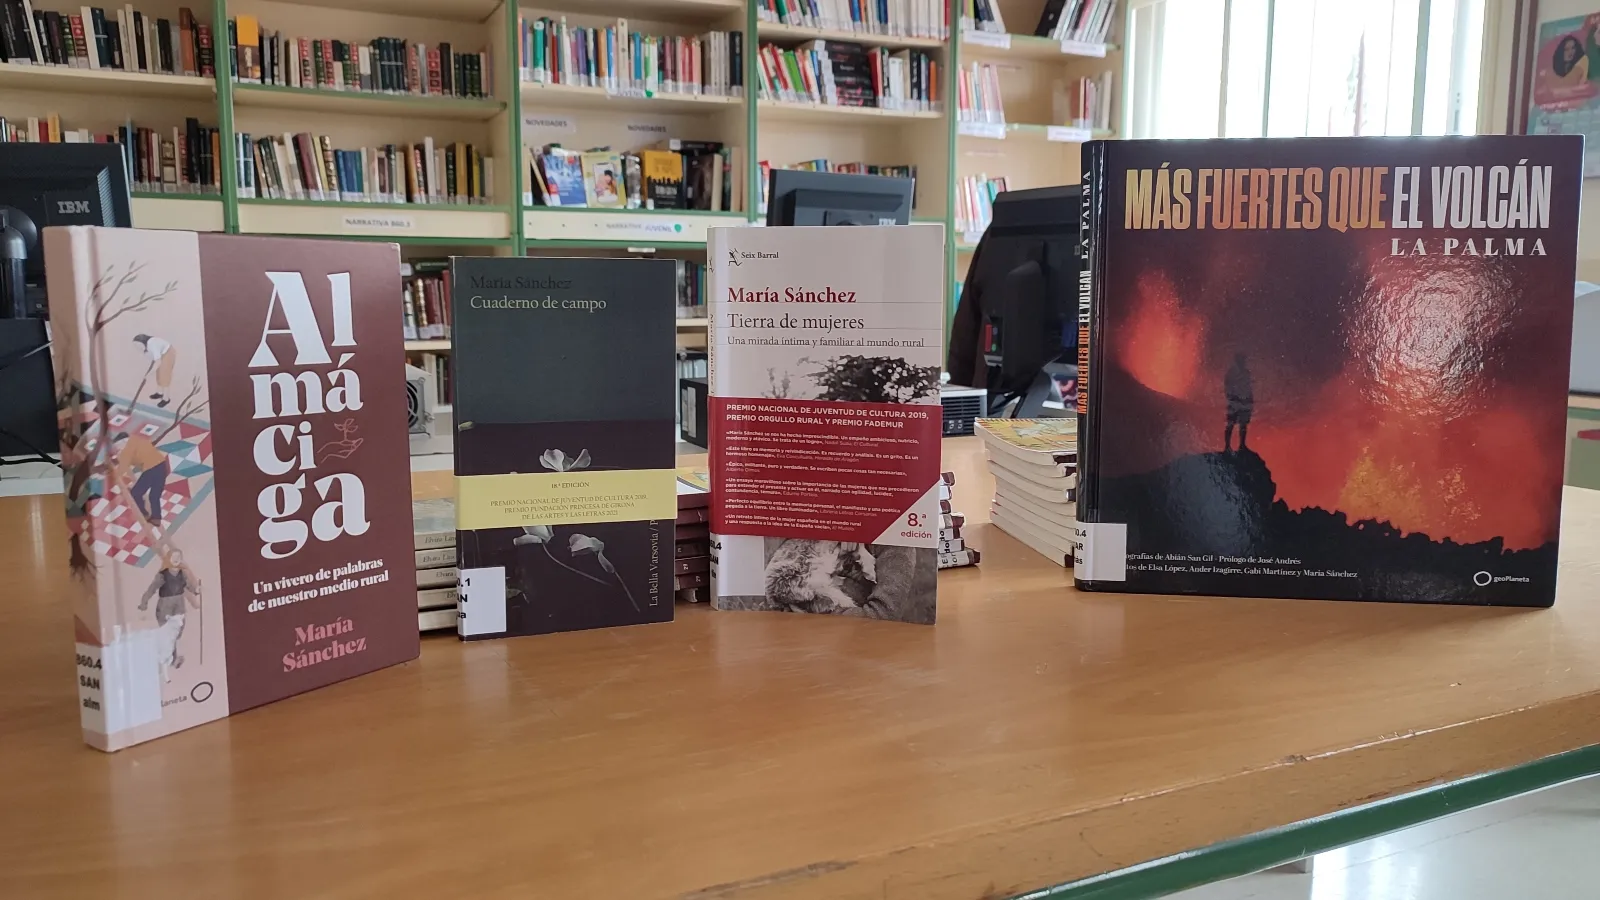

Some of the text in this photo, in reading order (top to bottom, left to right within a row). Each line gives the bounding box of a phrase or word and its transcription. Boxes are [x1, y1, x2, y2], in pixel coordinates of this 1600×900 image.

[525, 119, 568, 127] NOVEDADES
[1124, 158, 1552, 233] MÁS FUERTES QUE EL VOLCÁN
[57, 200, 90, 214] IBM
[1081, 171, 1090, 260] LA PALMA
[1390, 238, 1548, 256] LA PALMA
[470, 275, 572, 289] María Sánchez
[727, 286, 857, 303] María Sánchez
[470, 296, 607, 313] Cuaderno de campo
[248, 271, 358, 367] Al
[727, 313, 774, 328] Tierra
[779, 313, 798, 328] de
[802, 315, 864, 333] mujeres
[1079, 310, 1090, 323] EL
[727, 336, 924, 348] Una mirada íntima y familiar al mundo rural
[1078, 325, 1090, 344] QUE
[1078, 348, 1088, 389] FUERTES
[250, 353, 364, 419] má
[812, 407, 854, 415] JUVENTUD
[908, 412, 929, 420] 2019,
[252, 420, 317, 476] ci
[256, 473, 371, 560] ga
[1075, 528, 1087, 537] 0.4
[650, 533, 658, 571] Varsovia
[1075, 542, 1084, 551] AR
[1075, 556, 1083, 564] ás
[1219, 555, 1246, 564] Prólogo
[253, 558, 383, 595] Un vivero de palabras
[1164, 564, 1188, 573] López,
[1326, 570, 1358, 578] Sánchez
[457, 578, 470, 587] 0.1
[649, 573, 658, 593] Bella
[248, 570, 389, 613] de nuestro medio rural
[649, 596, 658, 606] La
[294, 616, 353, 646] María
[282, 637, 366, 672] Sánchez
[80, 675, 100, 690] SAN
[161, 695, 187, 707] laneta
